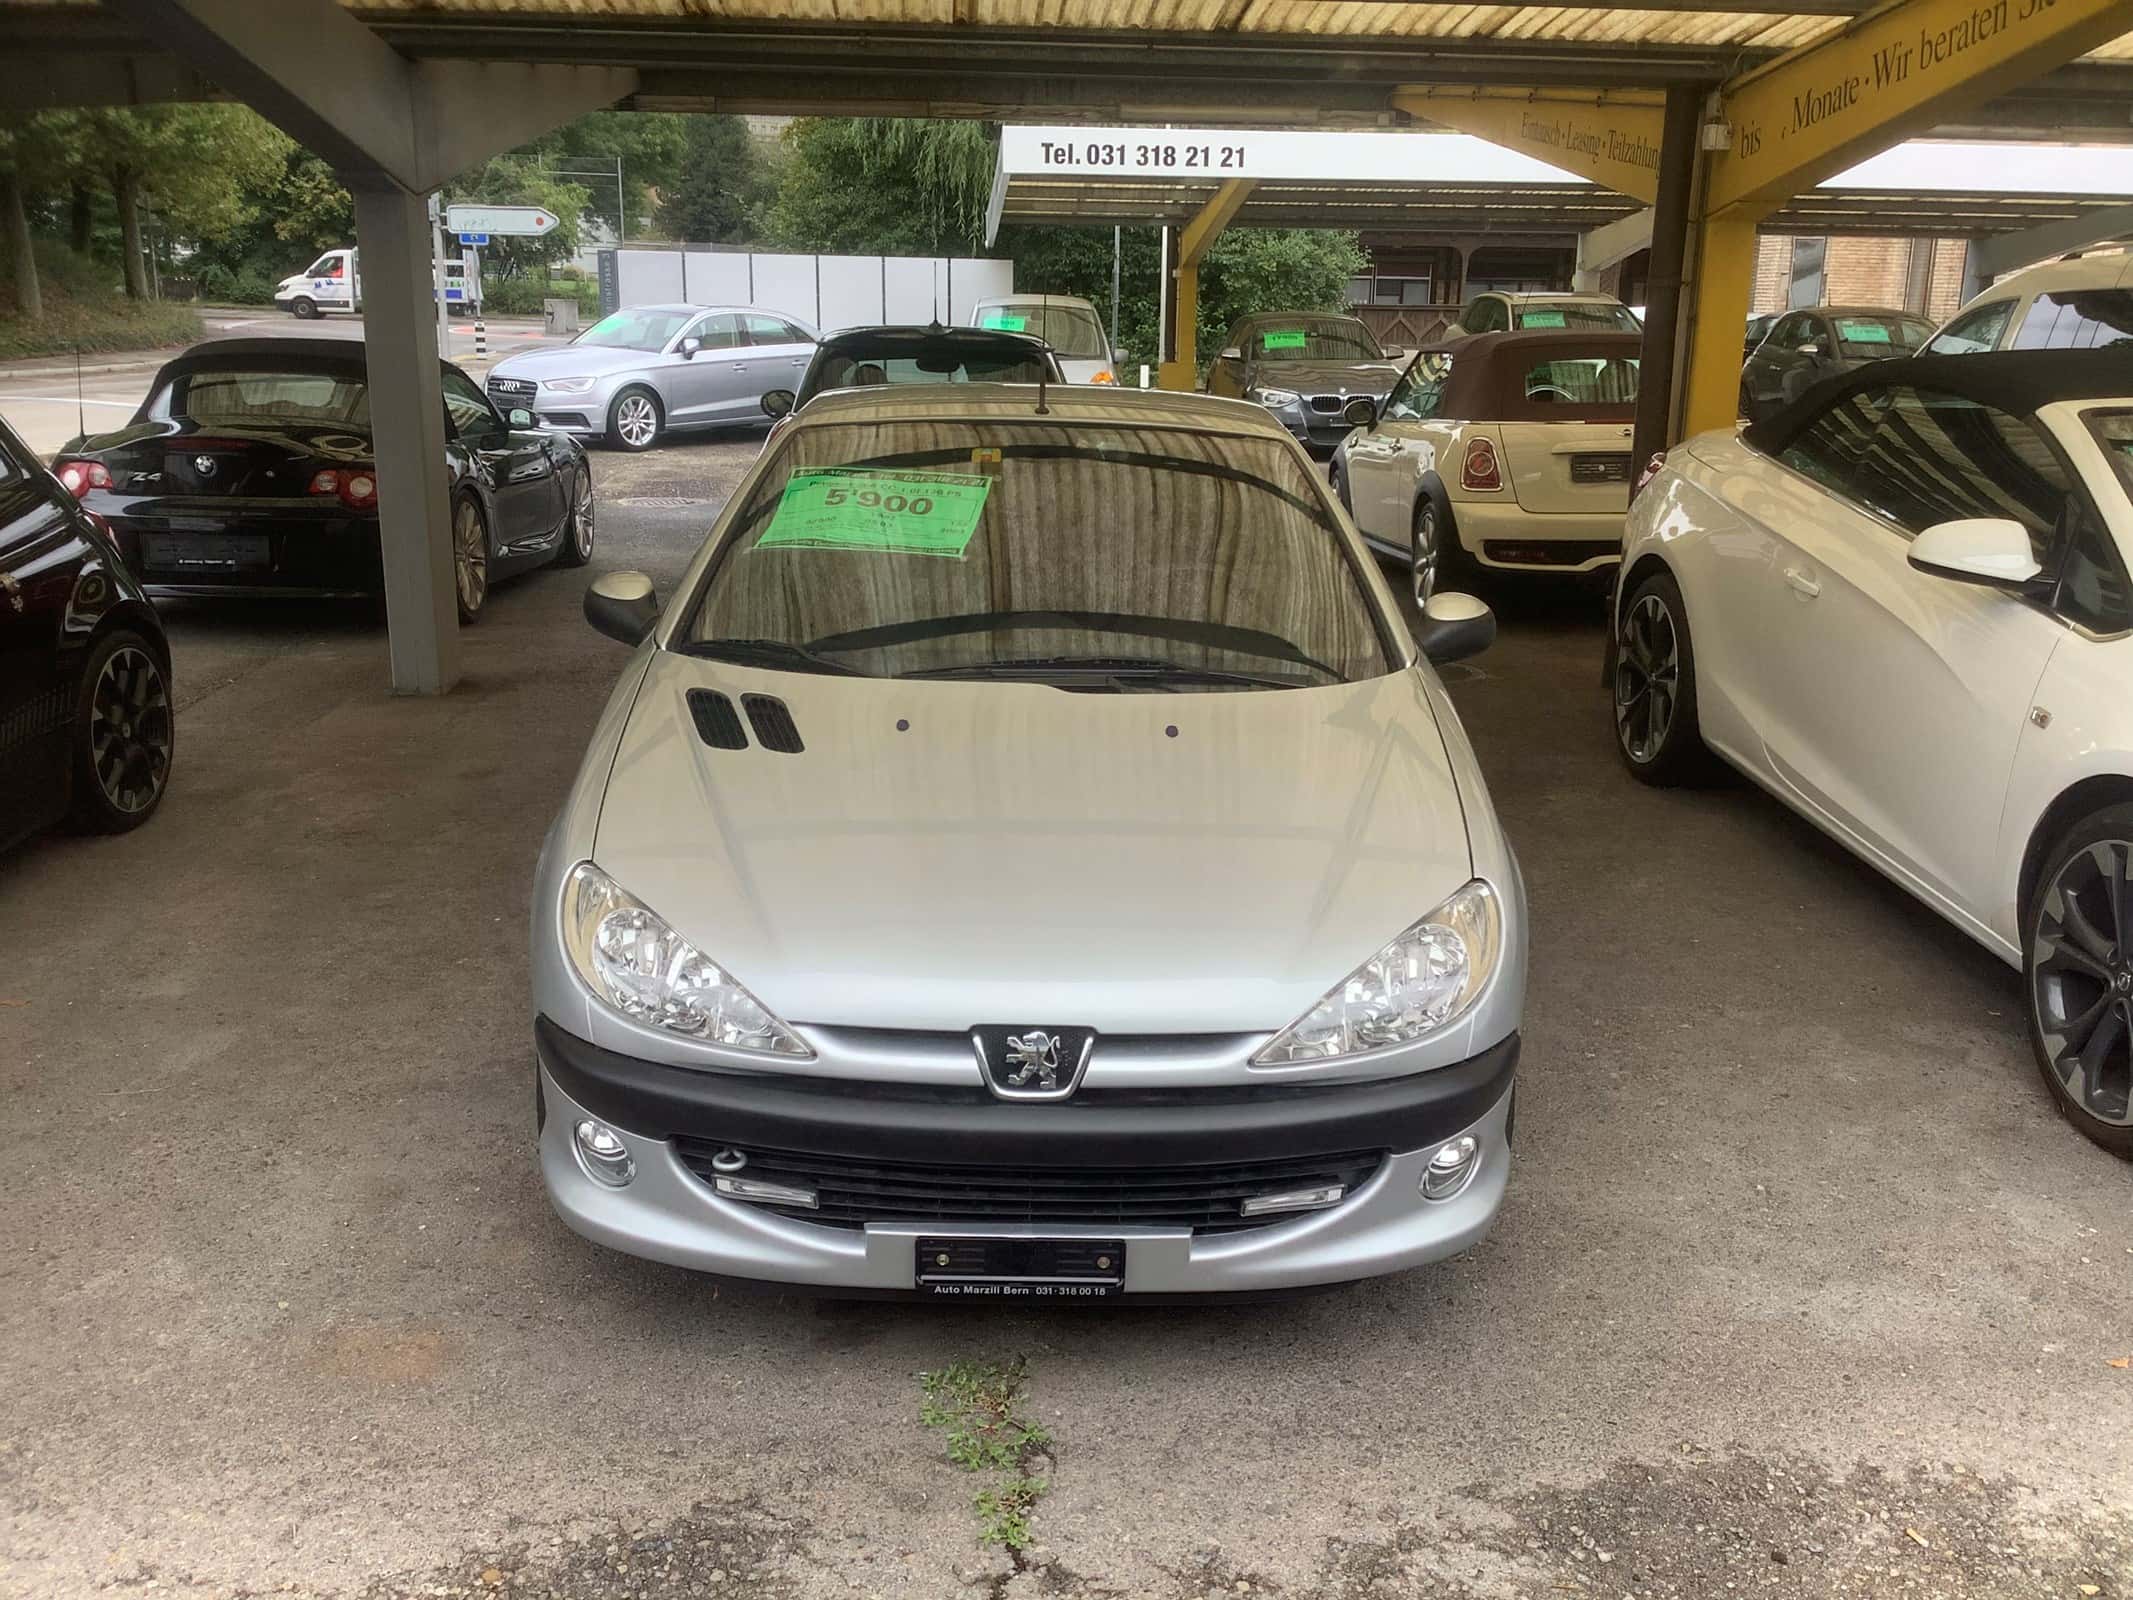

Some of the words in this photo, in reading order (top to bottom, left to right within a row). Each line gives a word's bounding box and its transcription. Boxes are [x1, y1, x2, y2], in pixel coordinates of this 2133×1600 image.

[1740, 120, 1761, 159] bis
[1791, 77, 1860, 134] Monate
[1872, 41, 1913, 91] Wir
[1919, 0, 2008, 70] beraten
[1041, 142, 1081, 165] Tel.
[1086, 144, 1126, 166] 031
[1136, 145, 1176, 167] 318
[1185, 146, 1209, 168] 21
[1220, 146, 1245, 168] 21
[1608, 130, 1661, 175] Teilzahlun
[131, 471, 162, 482] Z4
[934, 1285, 960, 1294] Auto
[1003, 1286, 1029, 1295] Bern
[1079, 1287, 1092, 1296] 00
